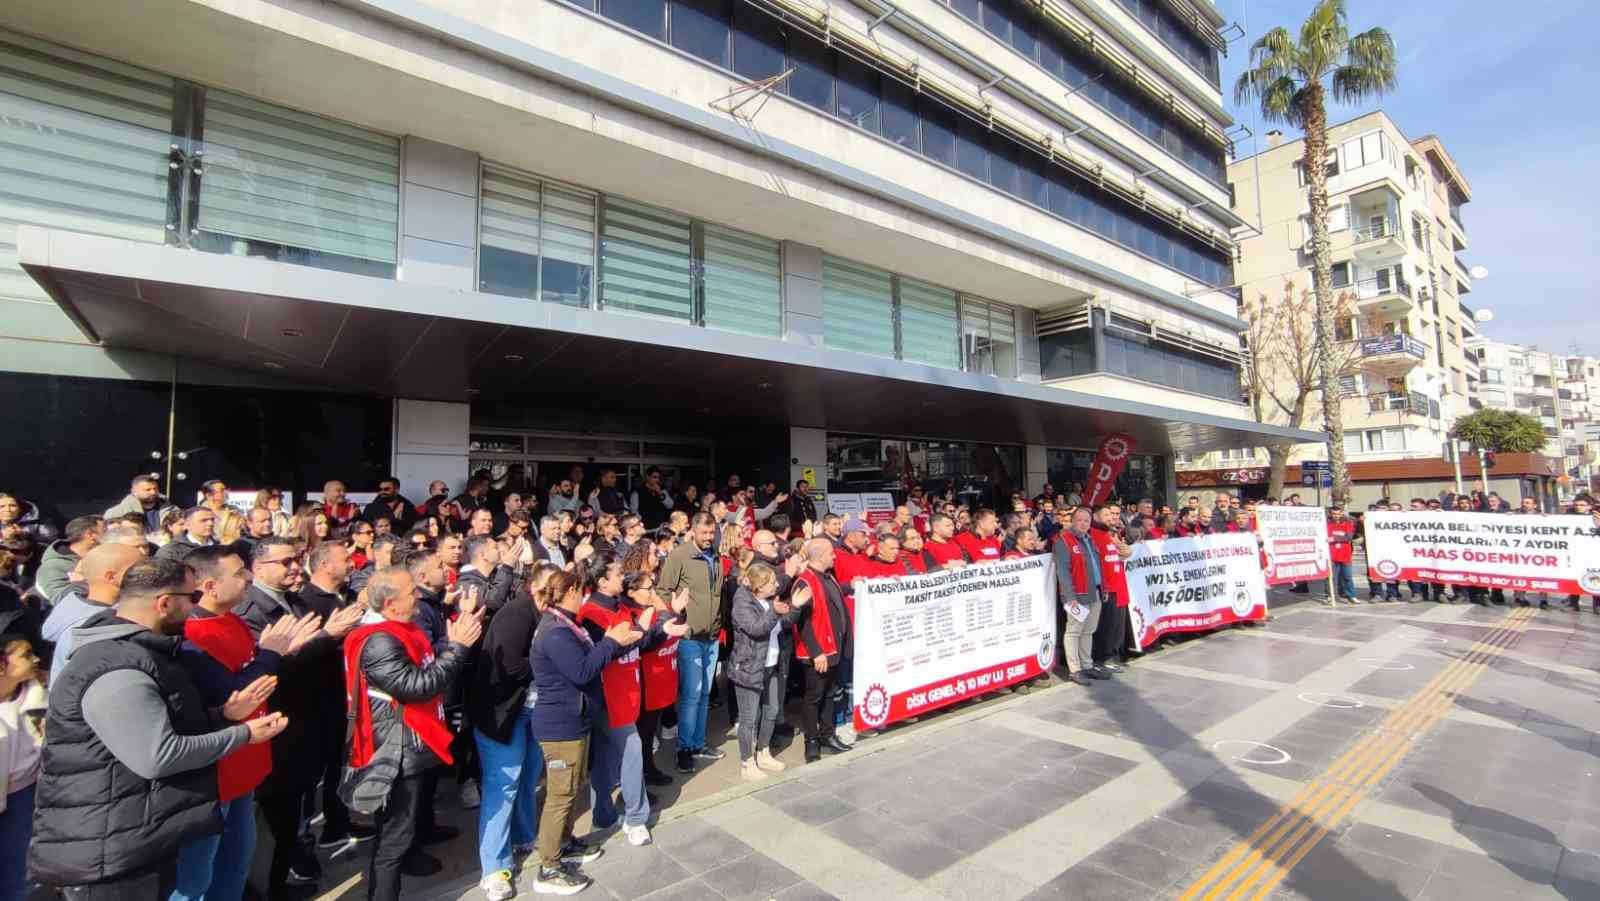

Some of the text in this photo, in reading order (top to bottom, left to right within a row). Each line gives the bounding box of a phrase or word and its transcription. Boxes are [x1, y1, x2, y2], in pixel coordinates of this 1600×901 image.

[1375, 521, 1444, 532] KARŞIYAKA
[1448, 522, 1527, 536] BELİYESİ
[1532, 526, 1569, 536] KENT
[1404, 535, 1569, 550] ÇALIŞANLARA 7 AYDIR
[1413, 548, 1458, 561] MAAŞ
[1462, 548, 1558, 567] ÖDEMİYOR
[920, 571, 959, 589] BELEDİYESİ
[959, 568, 979, 582] KENT
[904, 591, 932, 605] TAKSİT
[933, 587, 956, 601] TAKSİT
[956, 580, 988, 595] ÖDENEN
[906, 693, 929, 710] DİSK
[929, 679, 967, 702] GENEL-İŞ
